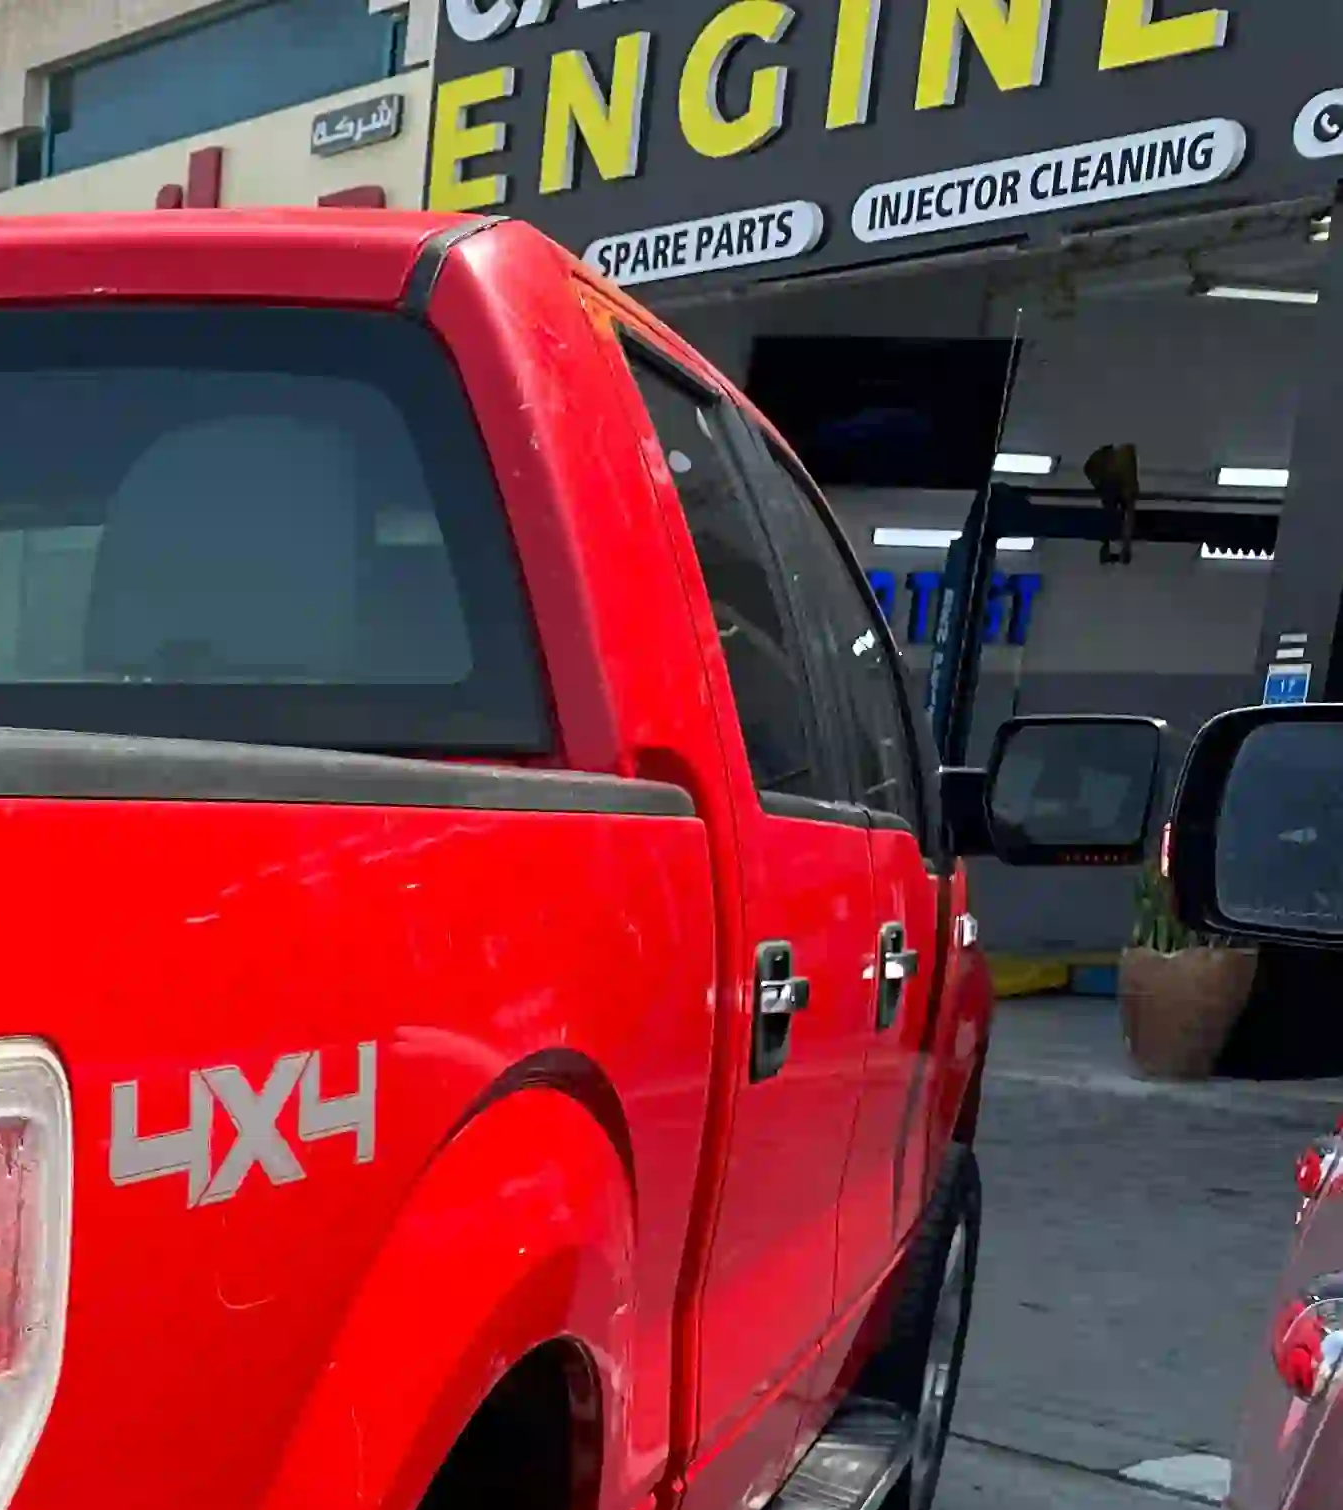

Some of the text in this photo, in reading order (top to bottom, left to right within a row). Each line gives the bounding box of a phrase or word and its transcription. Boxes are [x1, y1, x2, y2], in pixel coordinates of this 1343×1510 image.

[867, 131, 1215, 231] INJECTOR CLEANING
[597, 209, 794, 278] SPARE PARTS
